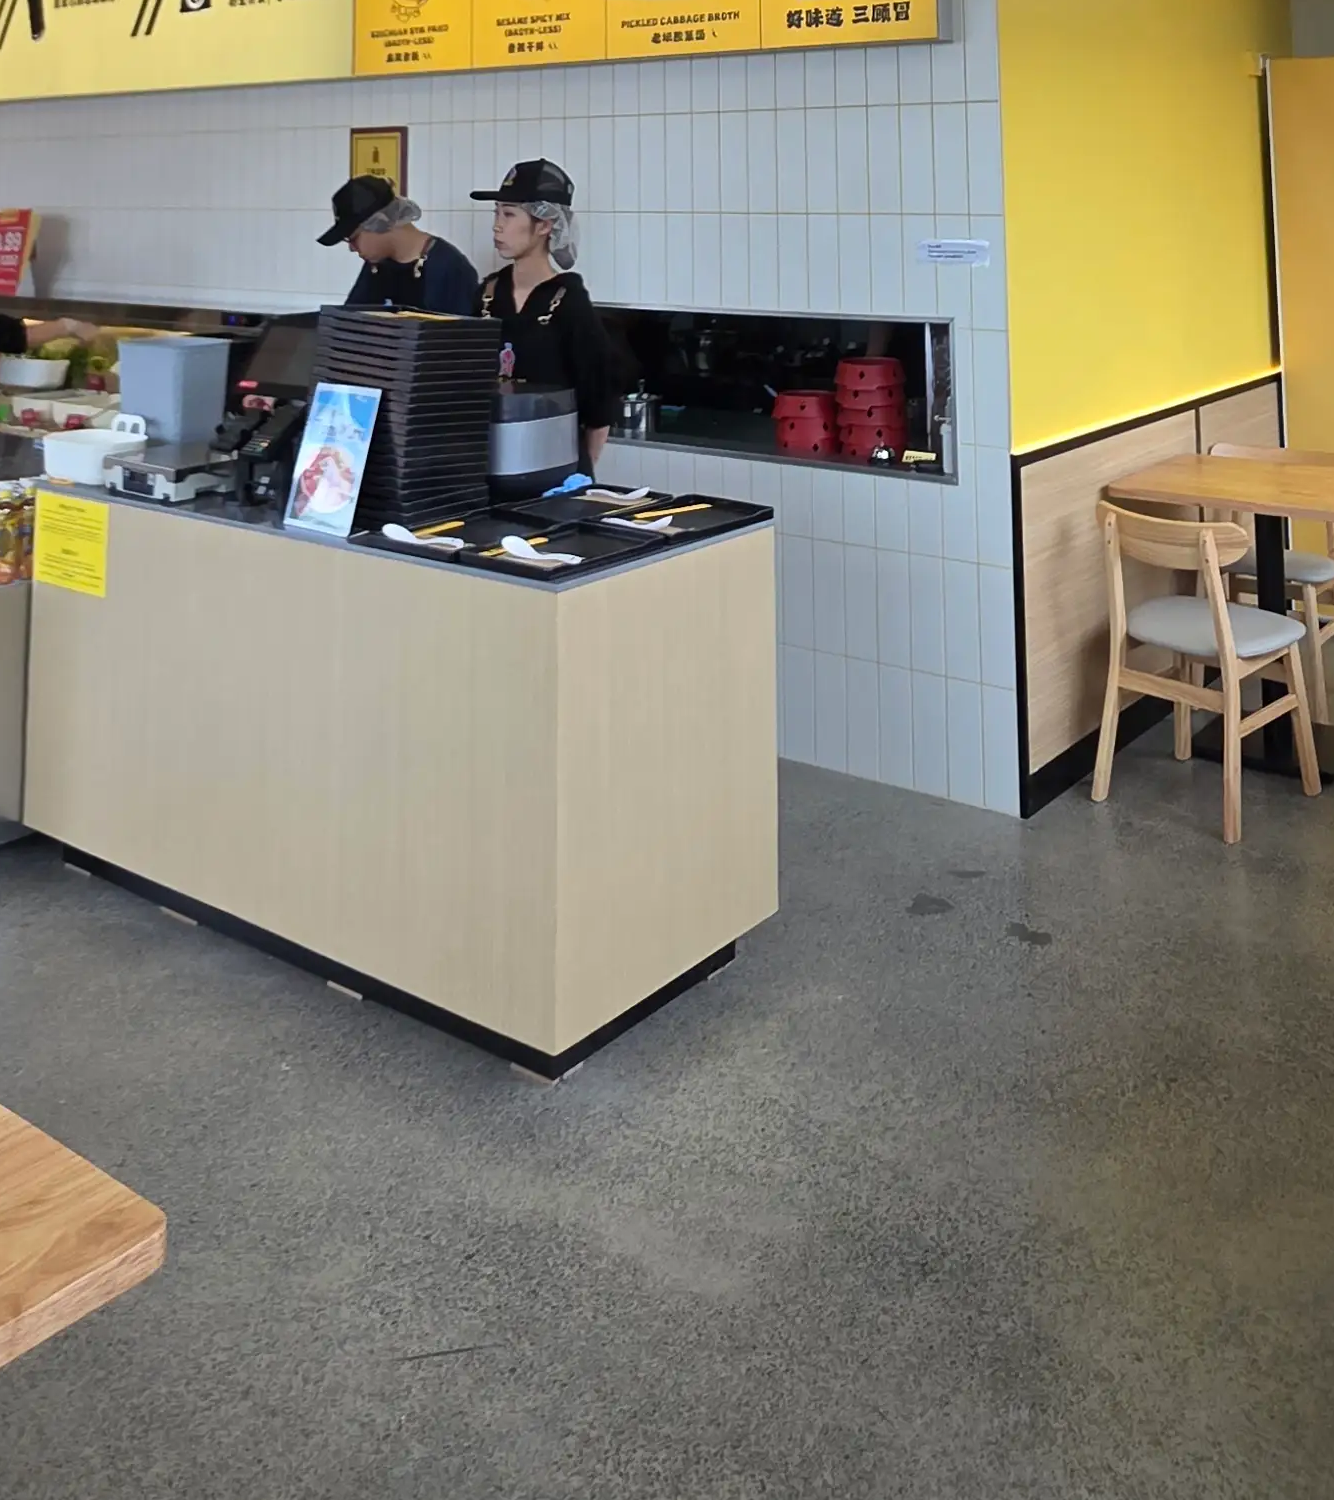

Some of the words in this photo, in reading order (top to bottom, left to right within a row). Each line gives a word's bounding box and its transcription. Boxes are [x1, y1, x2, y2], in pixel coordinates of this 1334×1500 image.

[530, 14, 553, 24] SPICY
[621, 18, 658, 28] PICKLED
[660, 13, 706, 25] CABBAGE
[707, 10, 740, 22] BROTH
[786, 6, 844, 29] 好味道
[852, 1, 911, 24] 三顾冒
